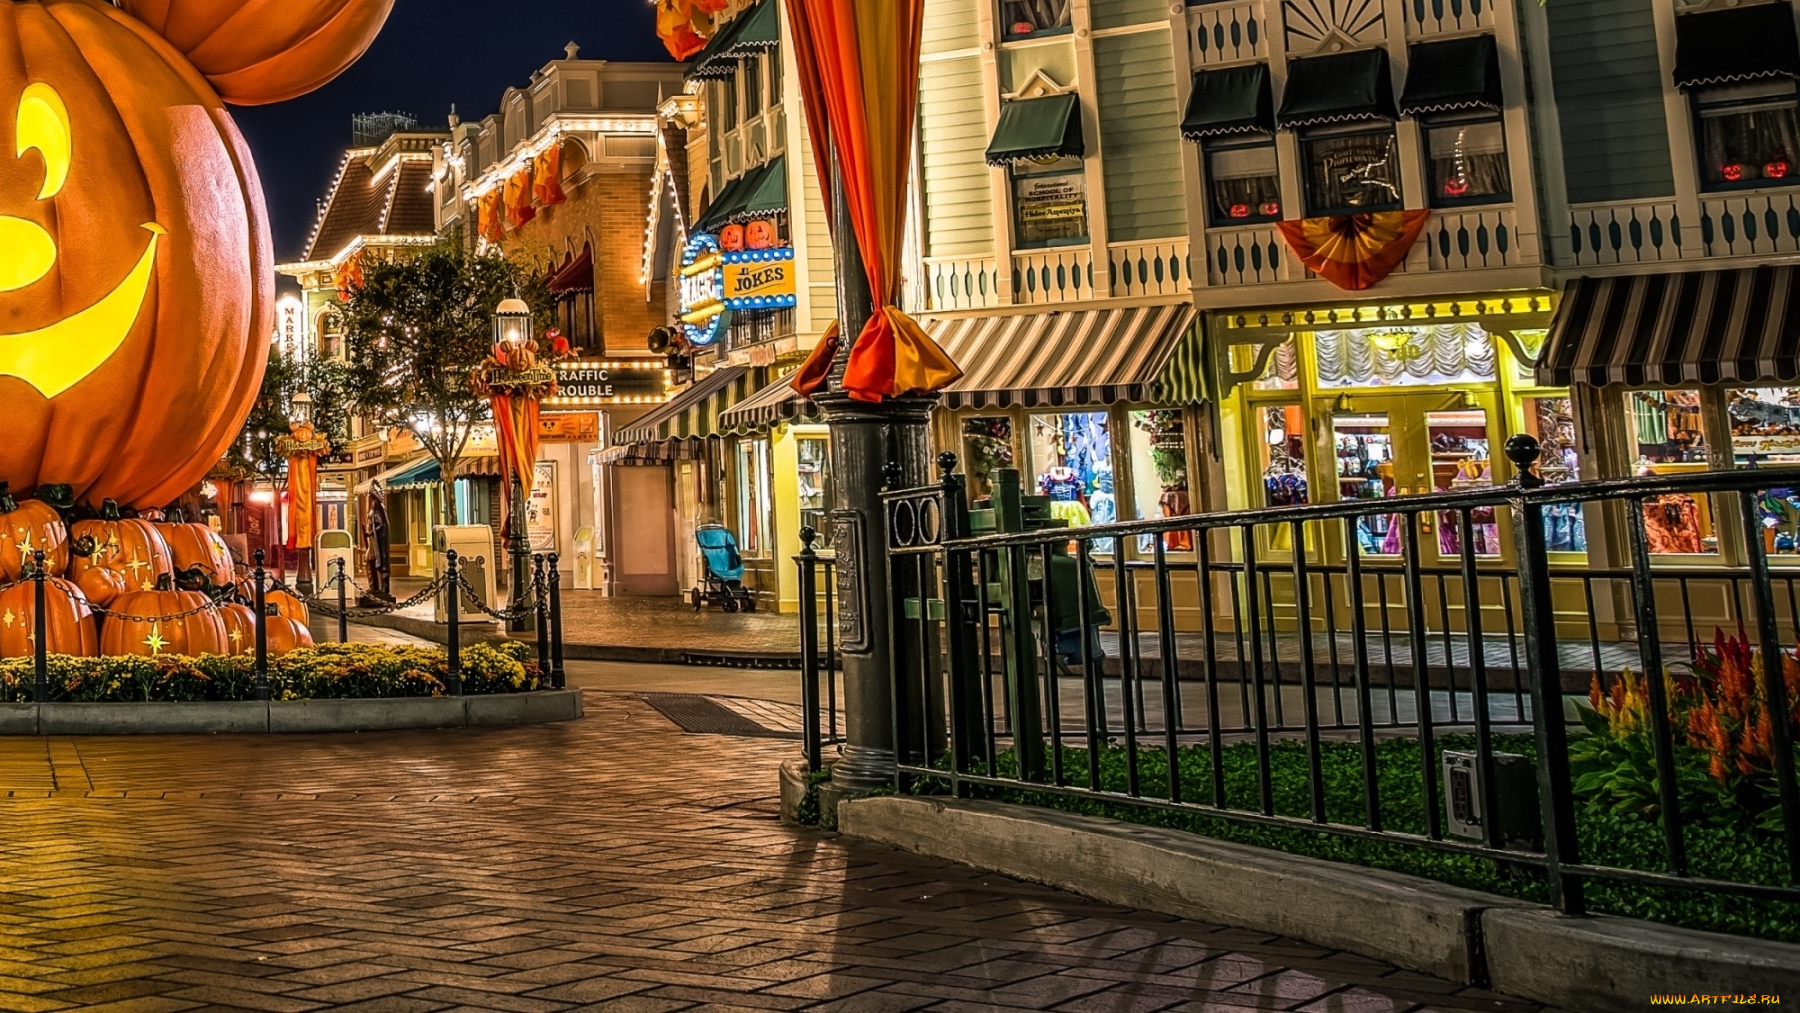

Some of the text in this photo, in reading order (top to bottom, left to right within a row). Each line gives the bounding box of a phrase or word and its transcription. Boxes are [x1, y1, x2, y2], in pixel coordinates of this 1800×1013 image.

[1025, 193, 1078, 203] HOSPITALITY
[1028, 189, 1061, 197] SCHOOL
[734, 267, 784, 292] JOKES
[559, 370, 608, 381] RAFFIC
[557, 385, 614, 396] ROUBLE
